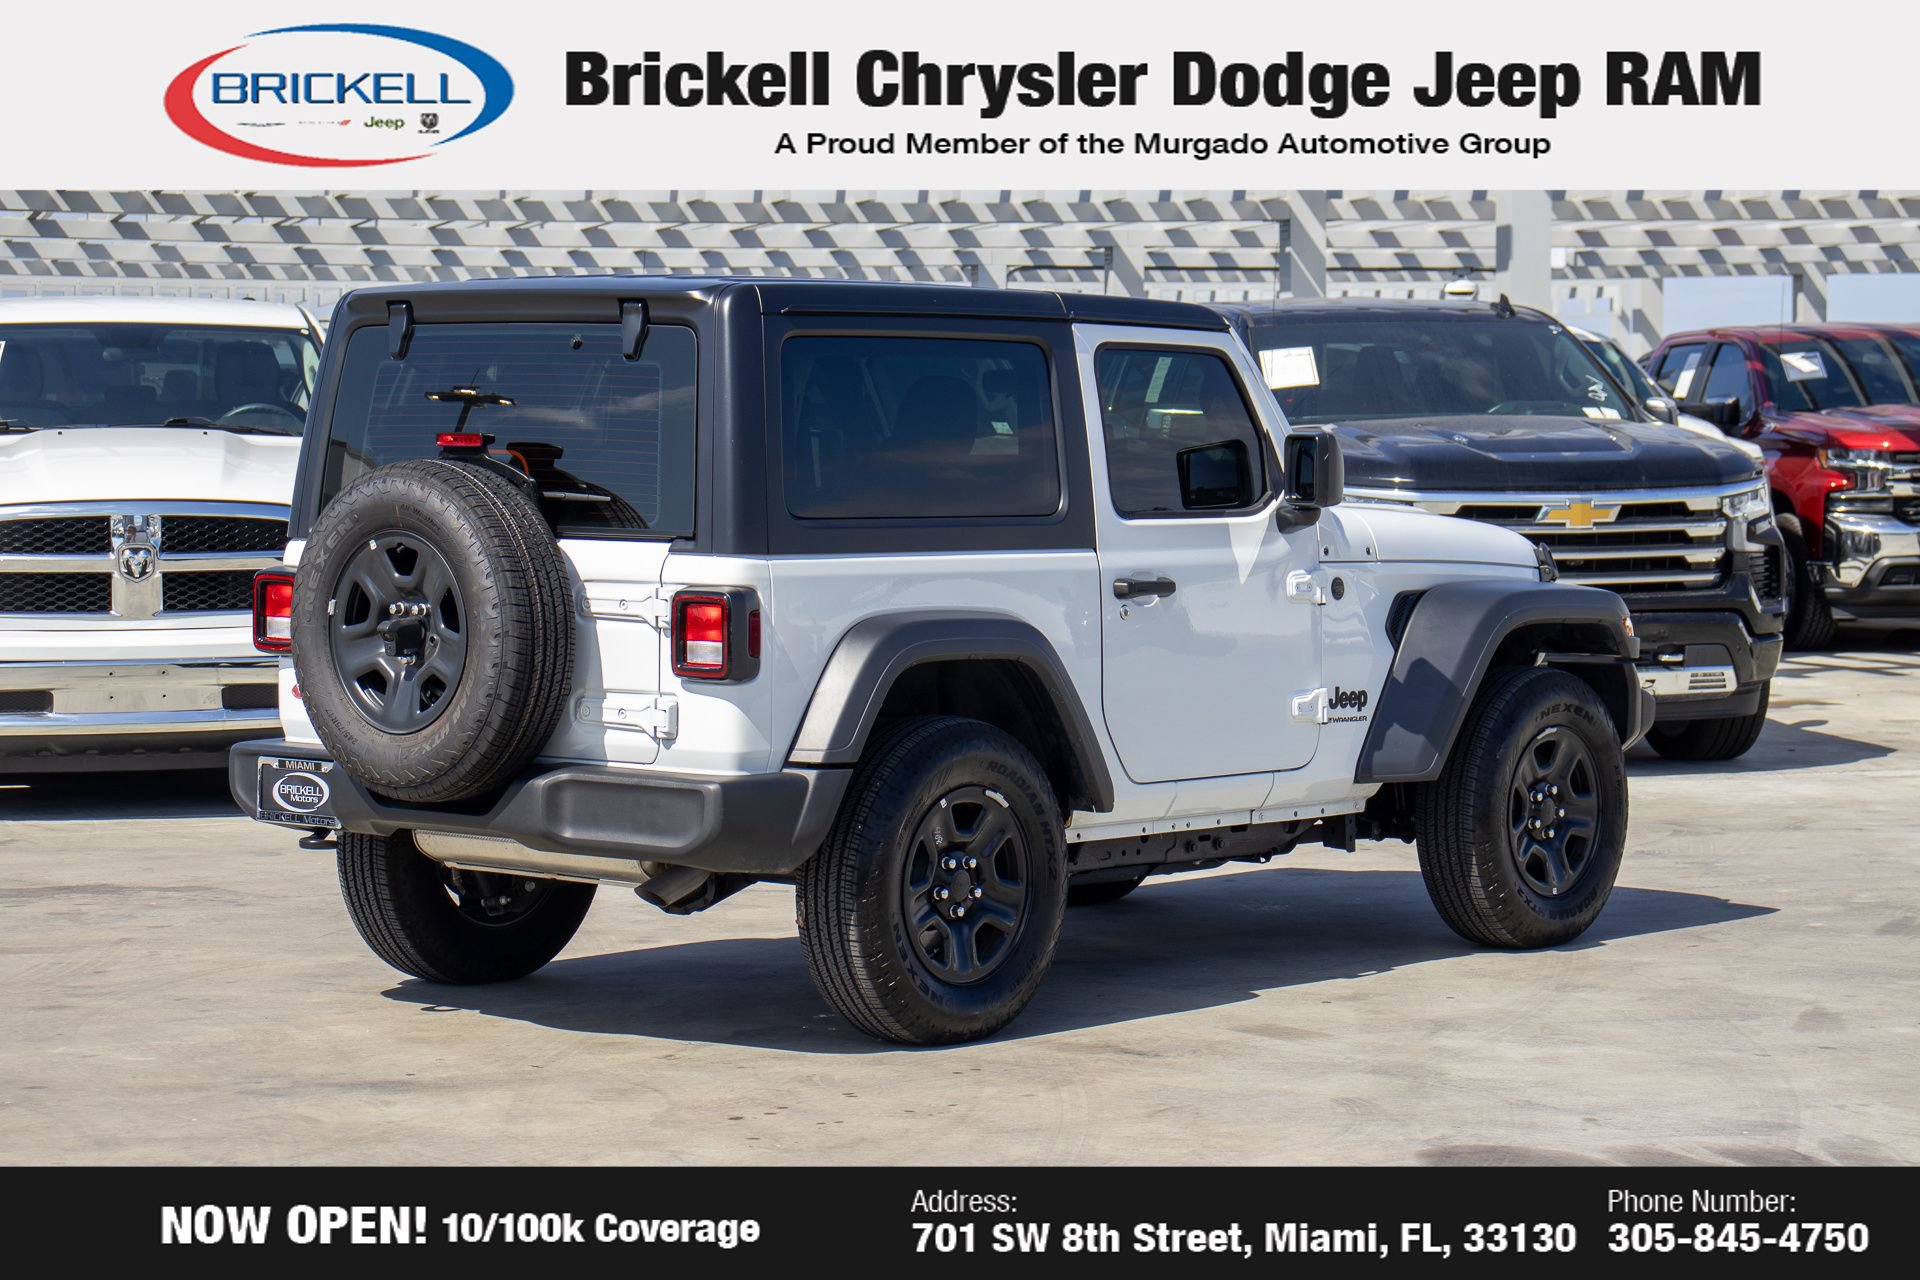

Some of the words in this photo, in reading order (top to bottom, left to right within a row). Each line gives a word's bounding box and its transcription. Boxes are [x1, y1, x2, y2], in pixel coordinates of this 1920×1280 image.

[304, 517, 354, 612] NEXEN
[1328, 686, 1368, 712] Jeep
[1332, 715, 1368, 723] WRANGLER
[1540, 703, 1594, 726] NEXEN
[285, 760, 315, 771] MIAMI
[280, 784, 322, 797] BRICKELL
[290, 794, 318, 804] Motors
[260, 811, 300, 822] BRICKELL
[303, 815, 336, 826] Motors
[893, 921, 945, 1006] NEXEN
